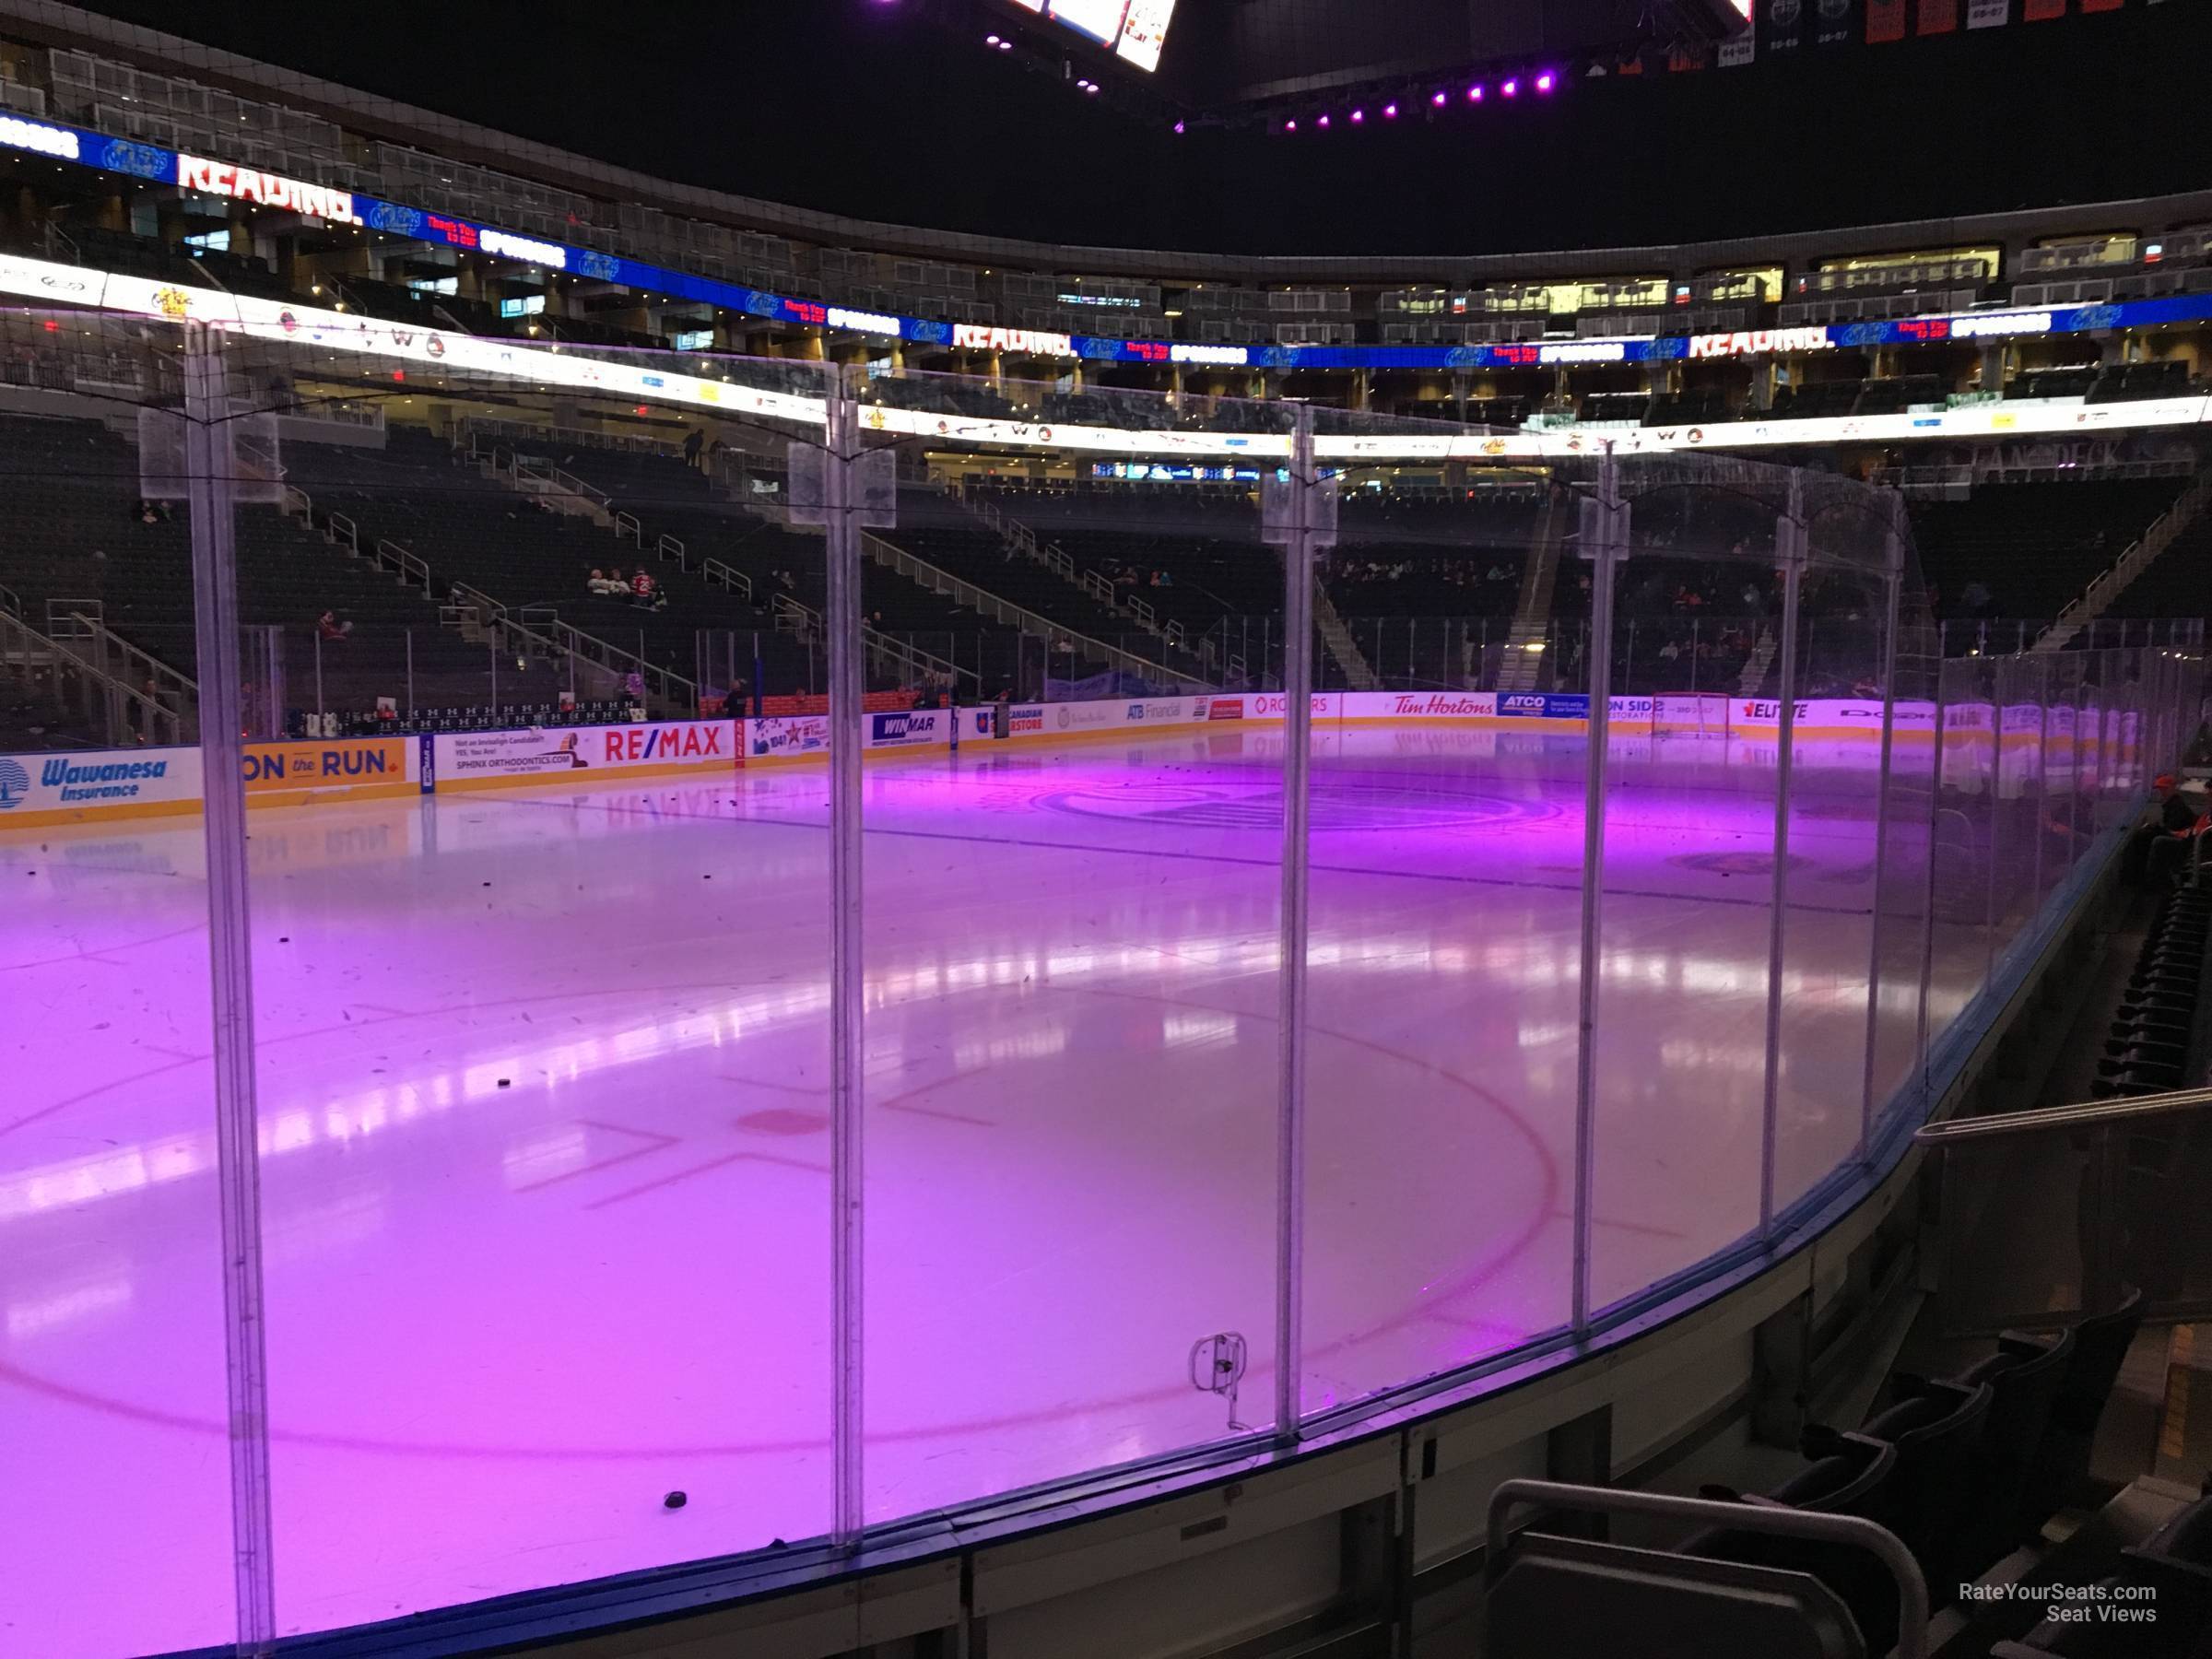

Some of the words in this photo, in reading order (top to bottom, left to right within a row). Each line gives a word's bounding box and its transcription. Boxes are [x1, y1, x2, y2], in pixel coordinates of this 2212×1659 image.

[1127, 704, 1144, 720] ATB
[1146, 701, 1181, 717] Financial
[1269, 699, 1327, 713] RORS
[1394, 695, 1424, 714] Tim
[1425, 693, 1494, 715] Hortons
[1505, 696, 1546, 708] ATCO
[885, 717, 935, 735] WINMAR
[606, 727, 720, 761] RE/MAX
[41, 759, 168, 787] Wawanesa
[242, 753, 285, 782] ON
[292, 759, 316, 772] the
[322, 748, 385, 777] RUN
[457, 760, 487, 771] SPHINX
[60, 783, 139, 802] Insurance
